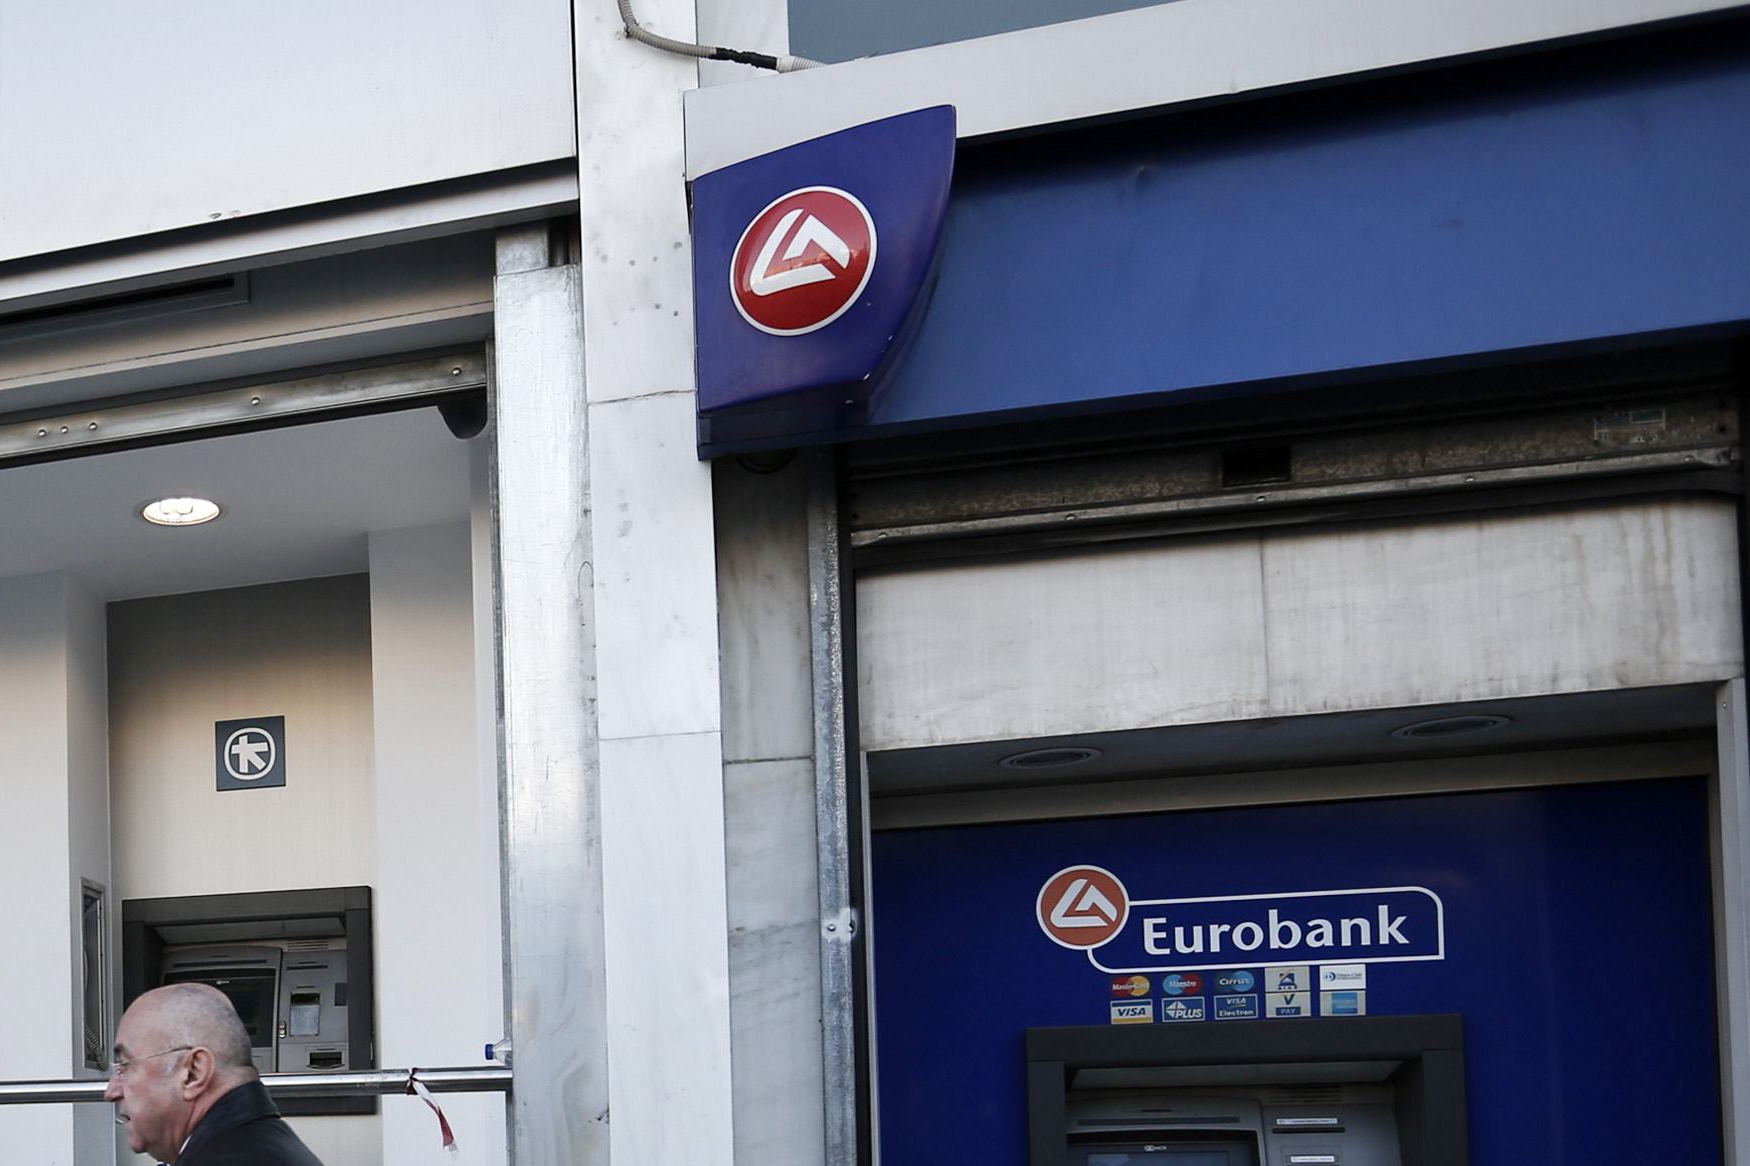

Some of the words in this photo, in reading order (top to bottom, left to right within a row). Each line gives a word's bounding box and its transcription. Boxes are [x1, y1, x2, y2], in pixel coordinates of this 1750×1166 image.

[1142, 904, 1410, 956] Eurobank
[1219, 978, 1251, 986] Cirrus
[1117, 1007, 1147, 1017] VISA
[1175, 1008, 1203, 1019] PLUS
[1219, 1009, 1254, 1017] Electron
